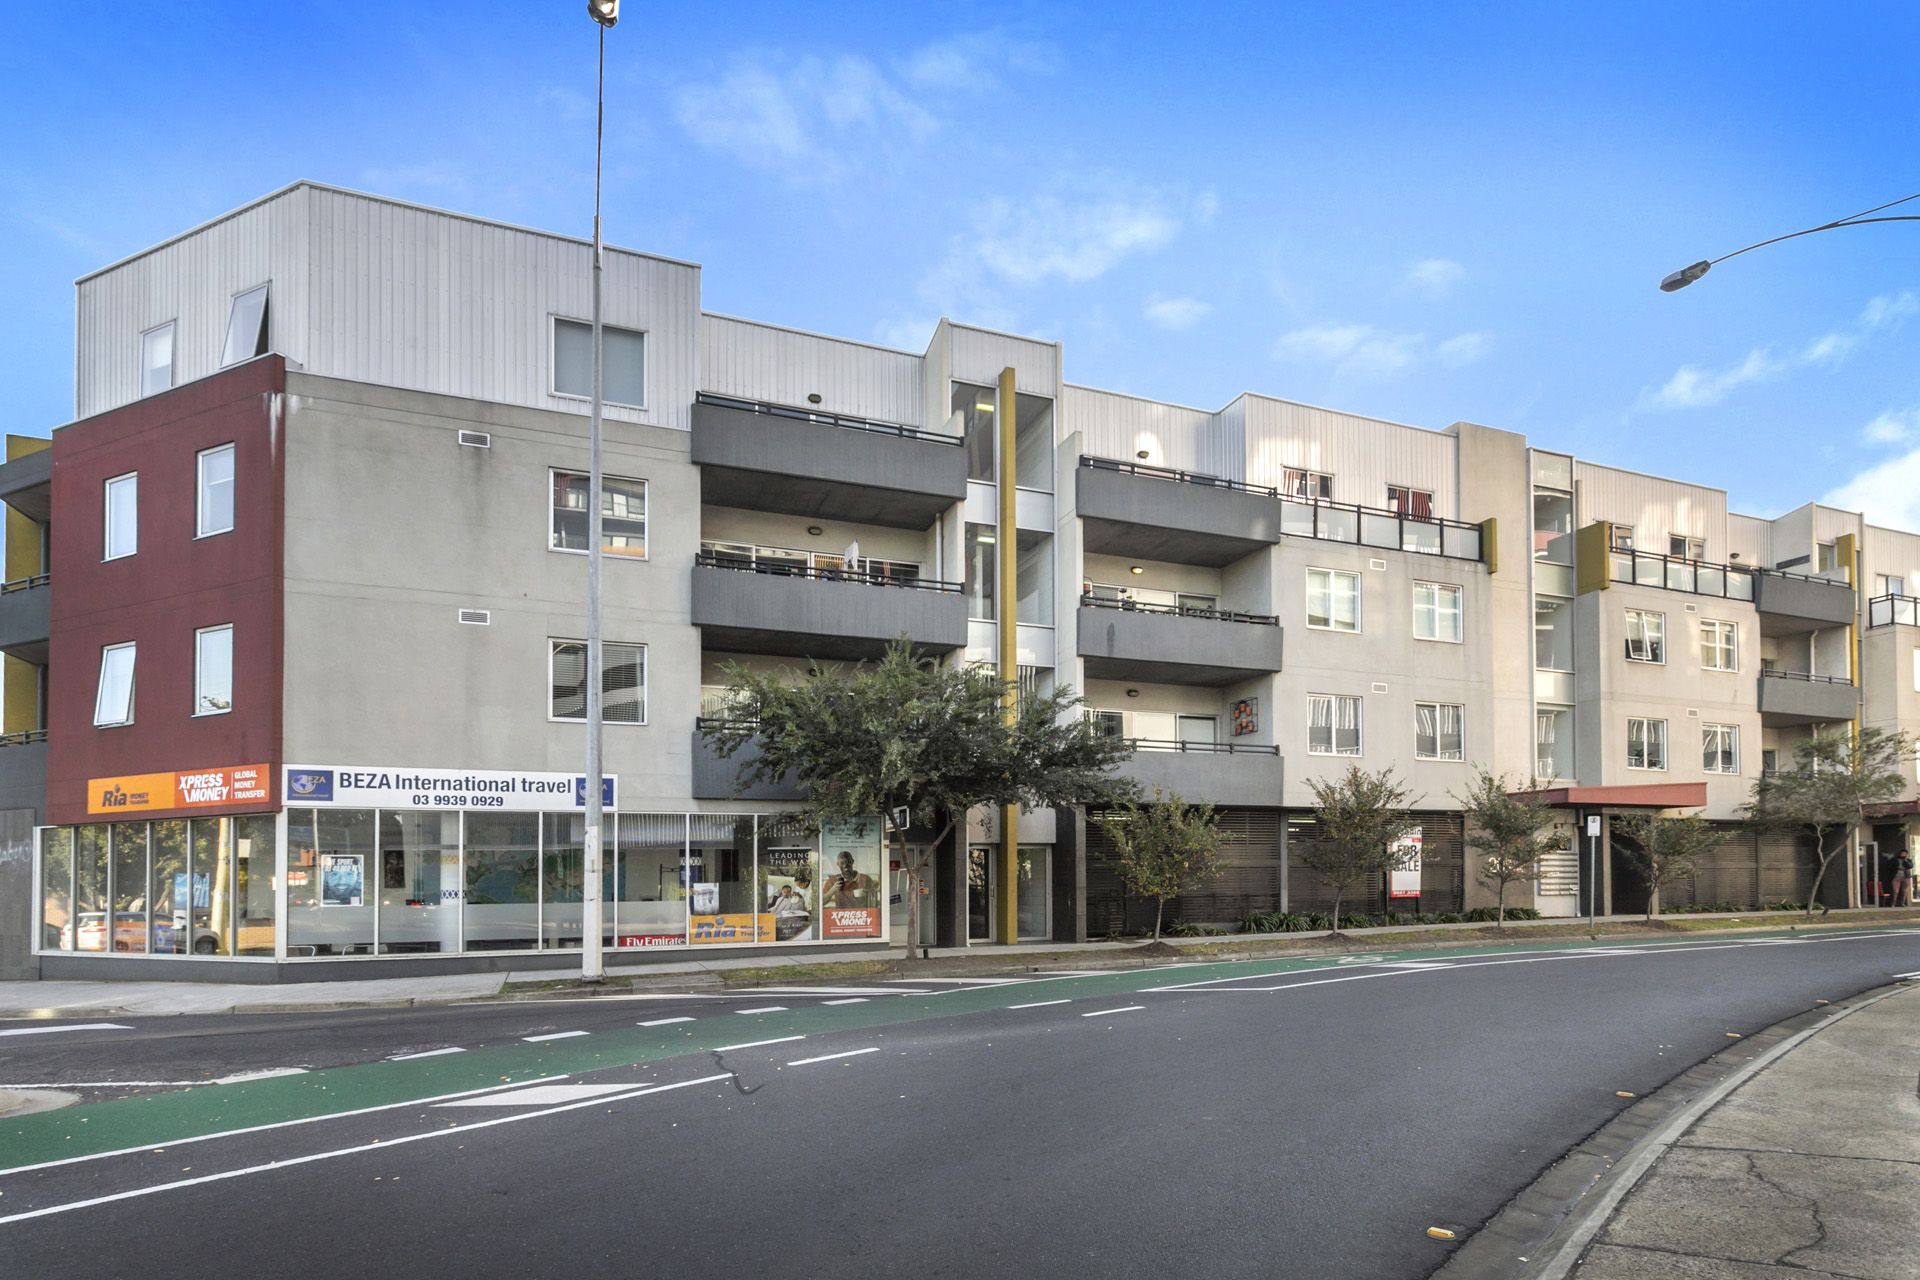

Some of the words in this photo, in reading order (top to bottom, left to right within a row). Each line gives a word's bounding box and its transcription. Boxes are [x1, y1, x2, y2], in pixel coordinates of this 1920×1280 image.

[234, 770, 257, 779] GLOBAL
[179, 773, 224, 790] XPRESS
[234, 780, 256, 790] MONEY
[340, 772, 392, 790] BEZA
[395, 774, 516, 793] International
[521, 777, 571, 794] travel
[102, 784, 128, 808] Ria
[187, 786, 229, 803] MONEY
[234, 789, 266, 800] TRANSFER
[413, 794, 429, 806] 03
[434, 795, 467, 807] 9939
[471, 796, 504, 807] 0929
[831, 911, 868, 920] XPRESS
[838, 917, 873, 926] MONEY
[694, 916, 736, 939] Ria
[740, 924, 764, 932] Mony
[740, 930, 771, 938] Tranfer
[645, 936, 687, 946] Emirates
